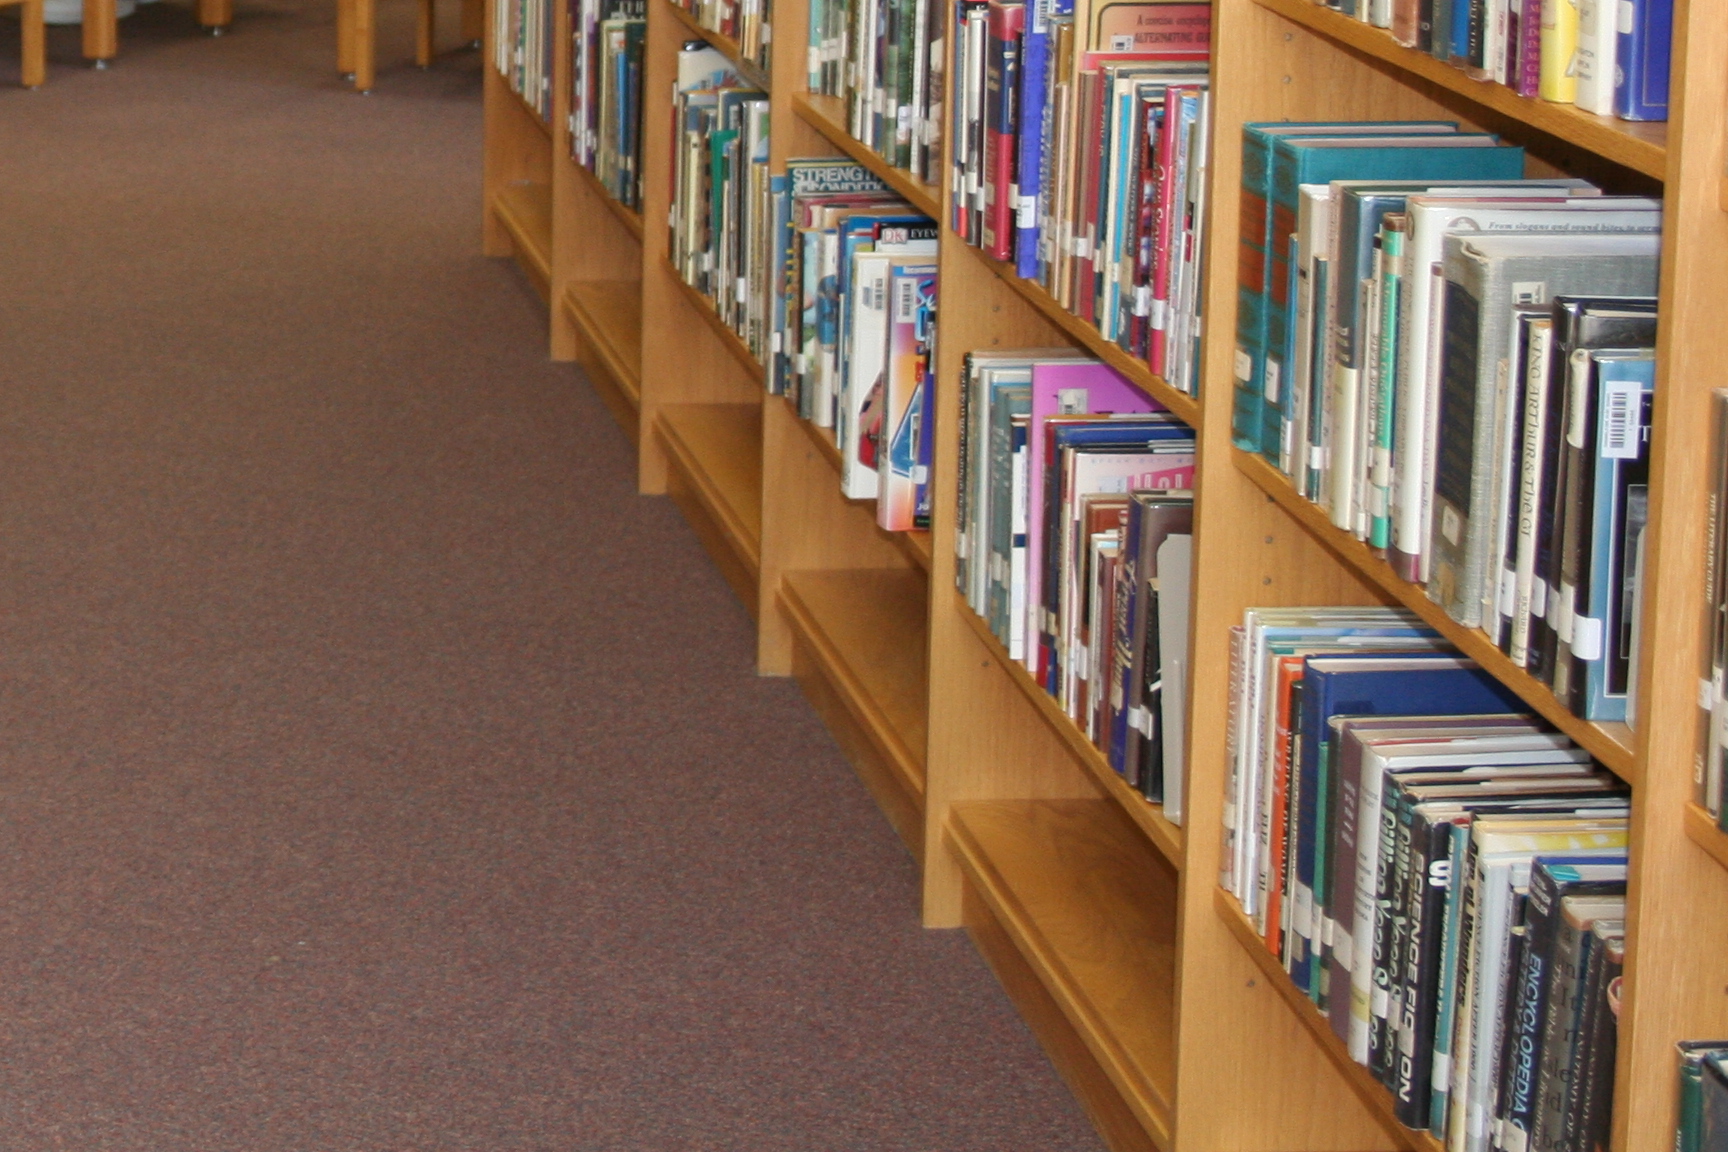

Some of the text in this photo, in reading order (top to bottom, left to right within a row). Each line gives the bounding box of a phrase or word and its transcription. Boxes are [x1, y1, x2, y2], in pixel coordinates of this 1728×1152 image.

[1529, 333, 1543, 381] KING
[1705, 516, 1716, 569] LITERARY
[1398, 850, 1425, 1104] SCIENCE FICON
[1512, 952, 1542, 1113] ENCYCLOPEDIA
